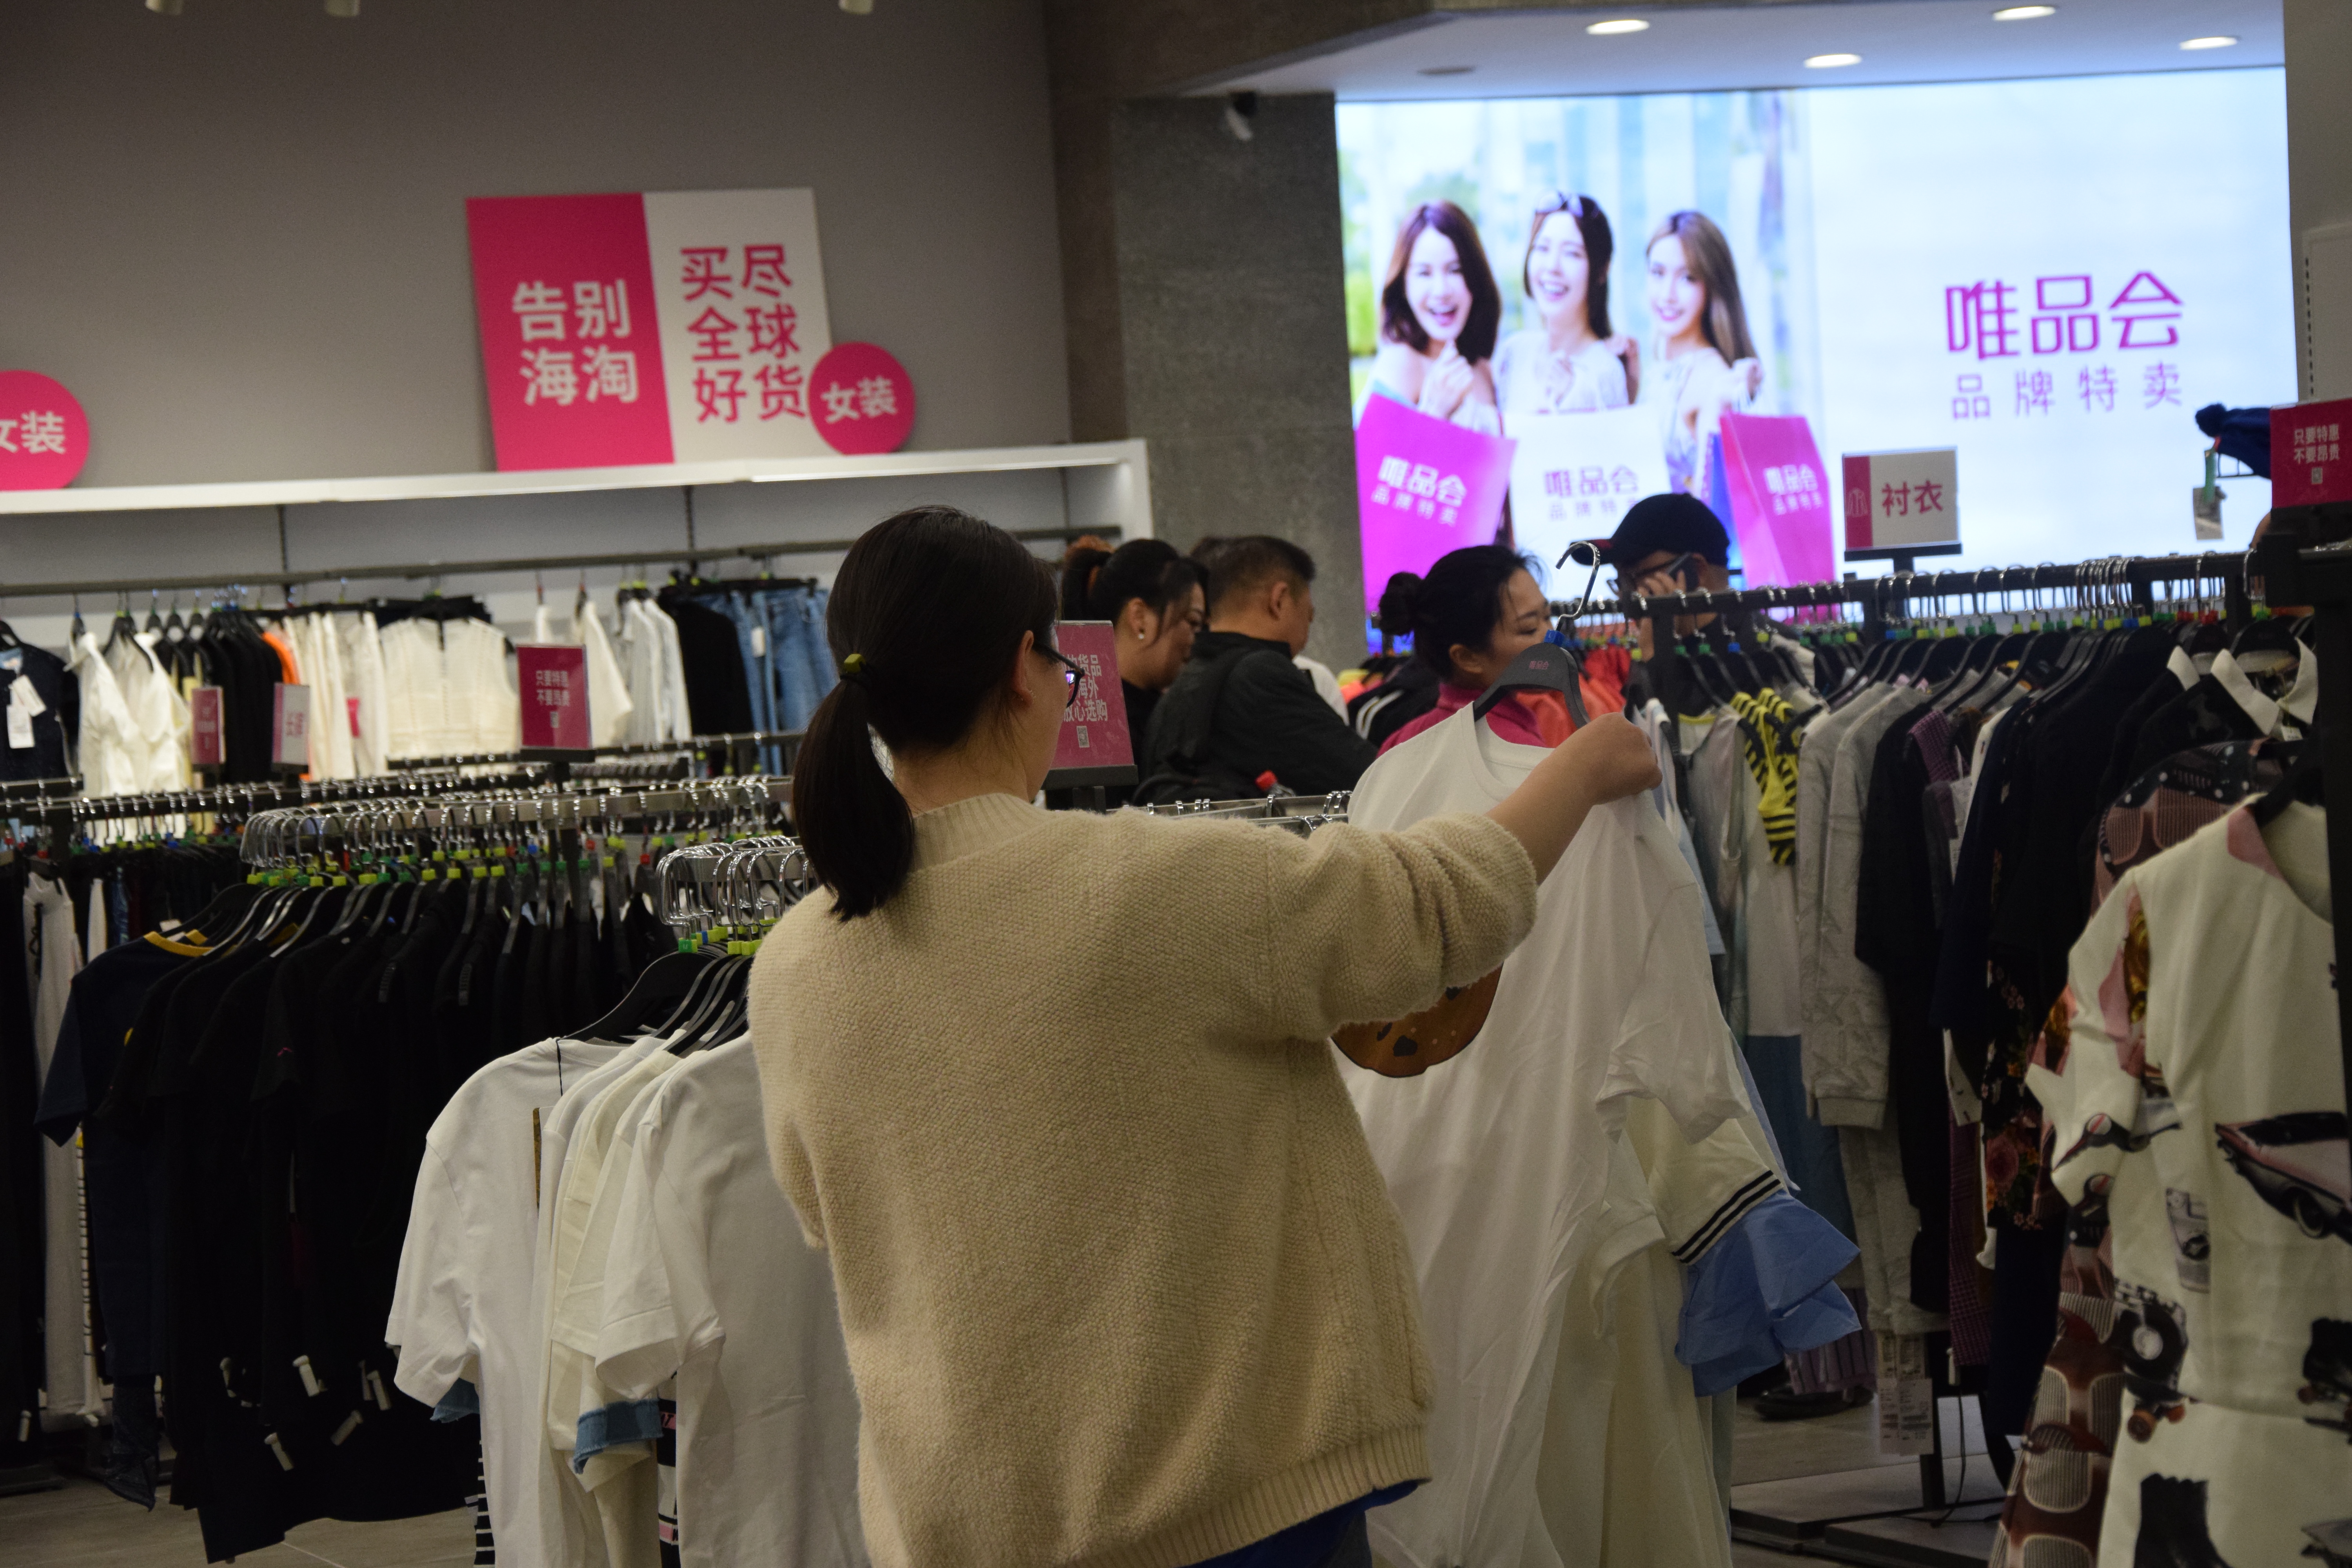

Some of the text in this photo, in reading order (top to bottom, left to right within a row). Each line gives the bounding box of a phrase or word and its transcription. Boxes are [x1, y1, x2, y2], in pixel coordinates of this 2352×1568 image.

[680, 245, 791, 301] 买尽
[512, 279, 631, 342] 告别
[686, 304, 800, 361] 全球
[1945, 271, 2184, 360] 唯品会
[520, 345, 639, 406] 海淘
[693, 365, 805, 423] 好货
[821, 376, 898, 423] 女装
[1951, 361, 2183, 421] 品牌特卖
[1882, 480, 1943, 517] 衬衣
